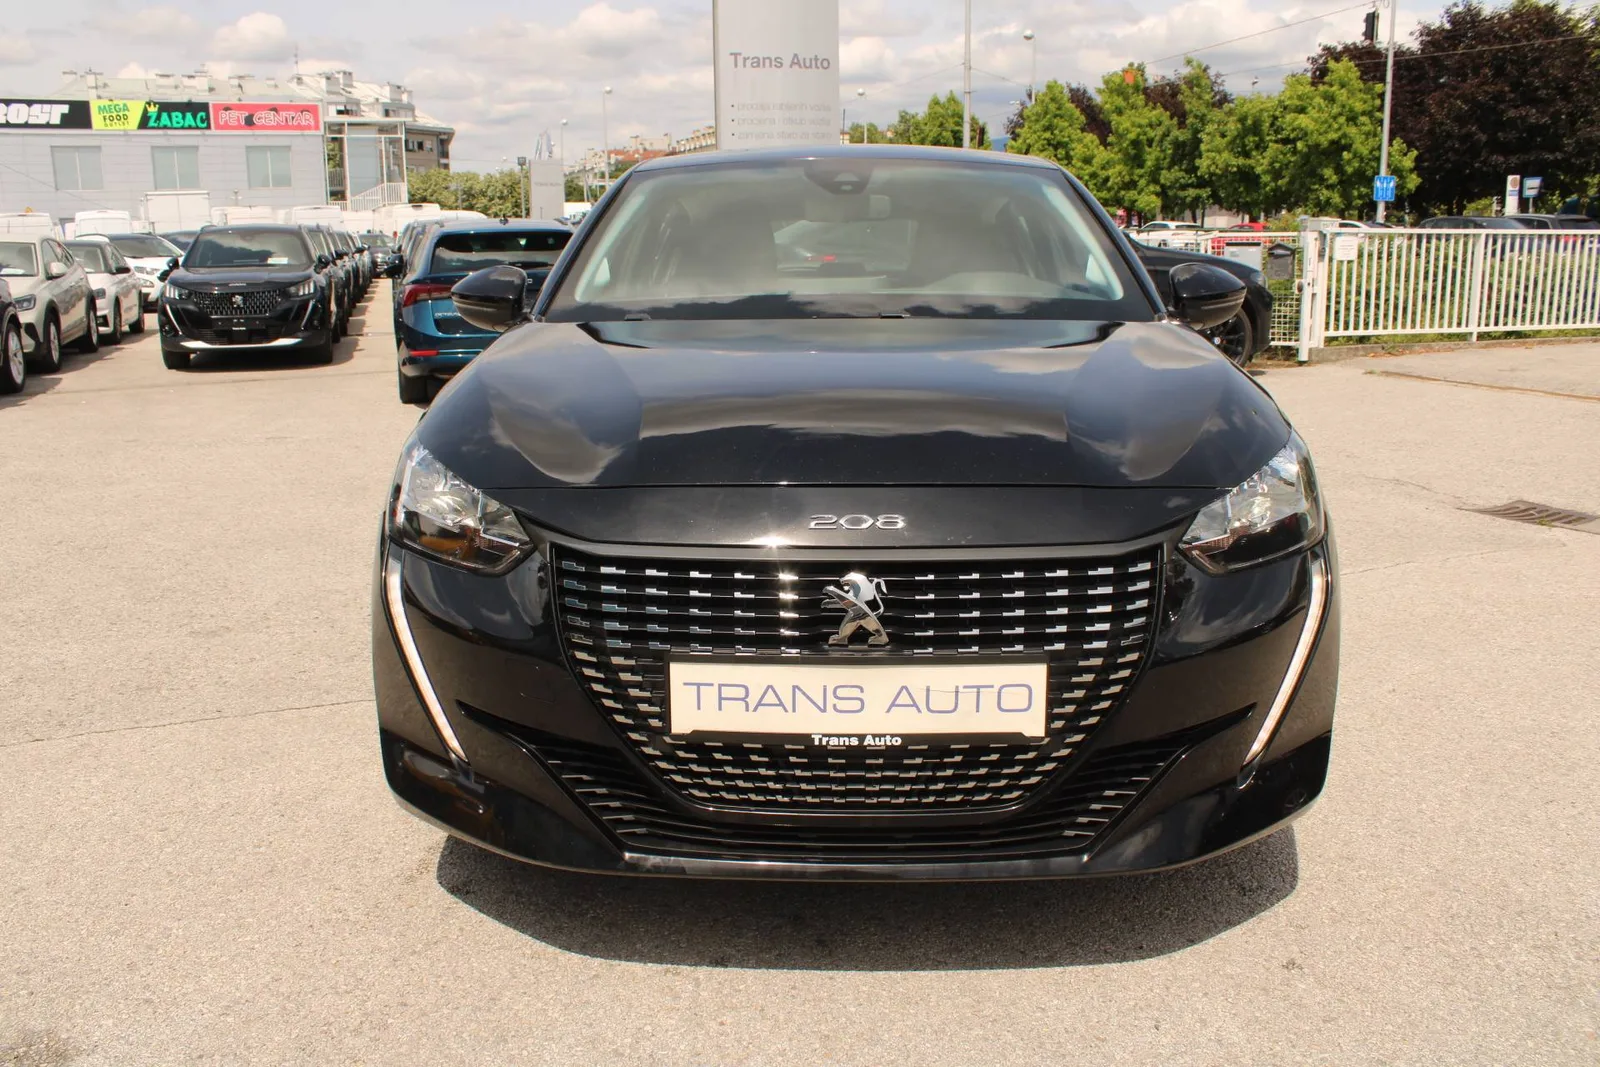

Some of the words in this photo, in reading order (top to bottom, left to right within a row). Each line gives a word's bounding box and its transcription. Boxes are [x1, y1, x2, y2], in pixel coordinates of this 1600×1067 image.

[729, 52, 784, 69] Trans
[789, 53, 831, 70] Auto
[97, 103, 130, 115] MEGA
[103, 113, 129, 123] FOOD
[219, 110, 249, 126] PET
[252, 110, 315, 126] CENTAR
[808, 514, 906, 530] 208
[682, 681, 866, 714] TRANS
[885, 683, 1033, 714] AUTO
[811, 734, 859, 746] Trans
[863, 734, 902, 746] Auto
